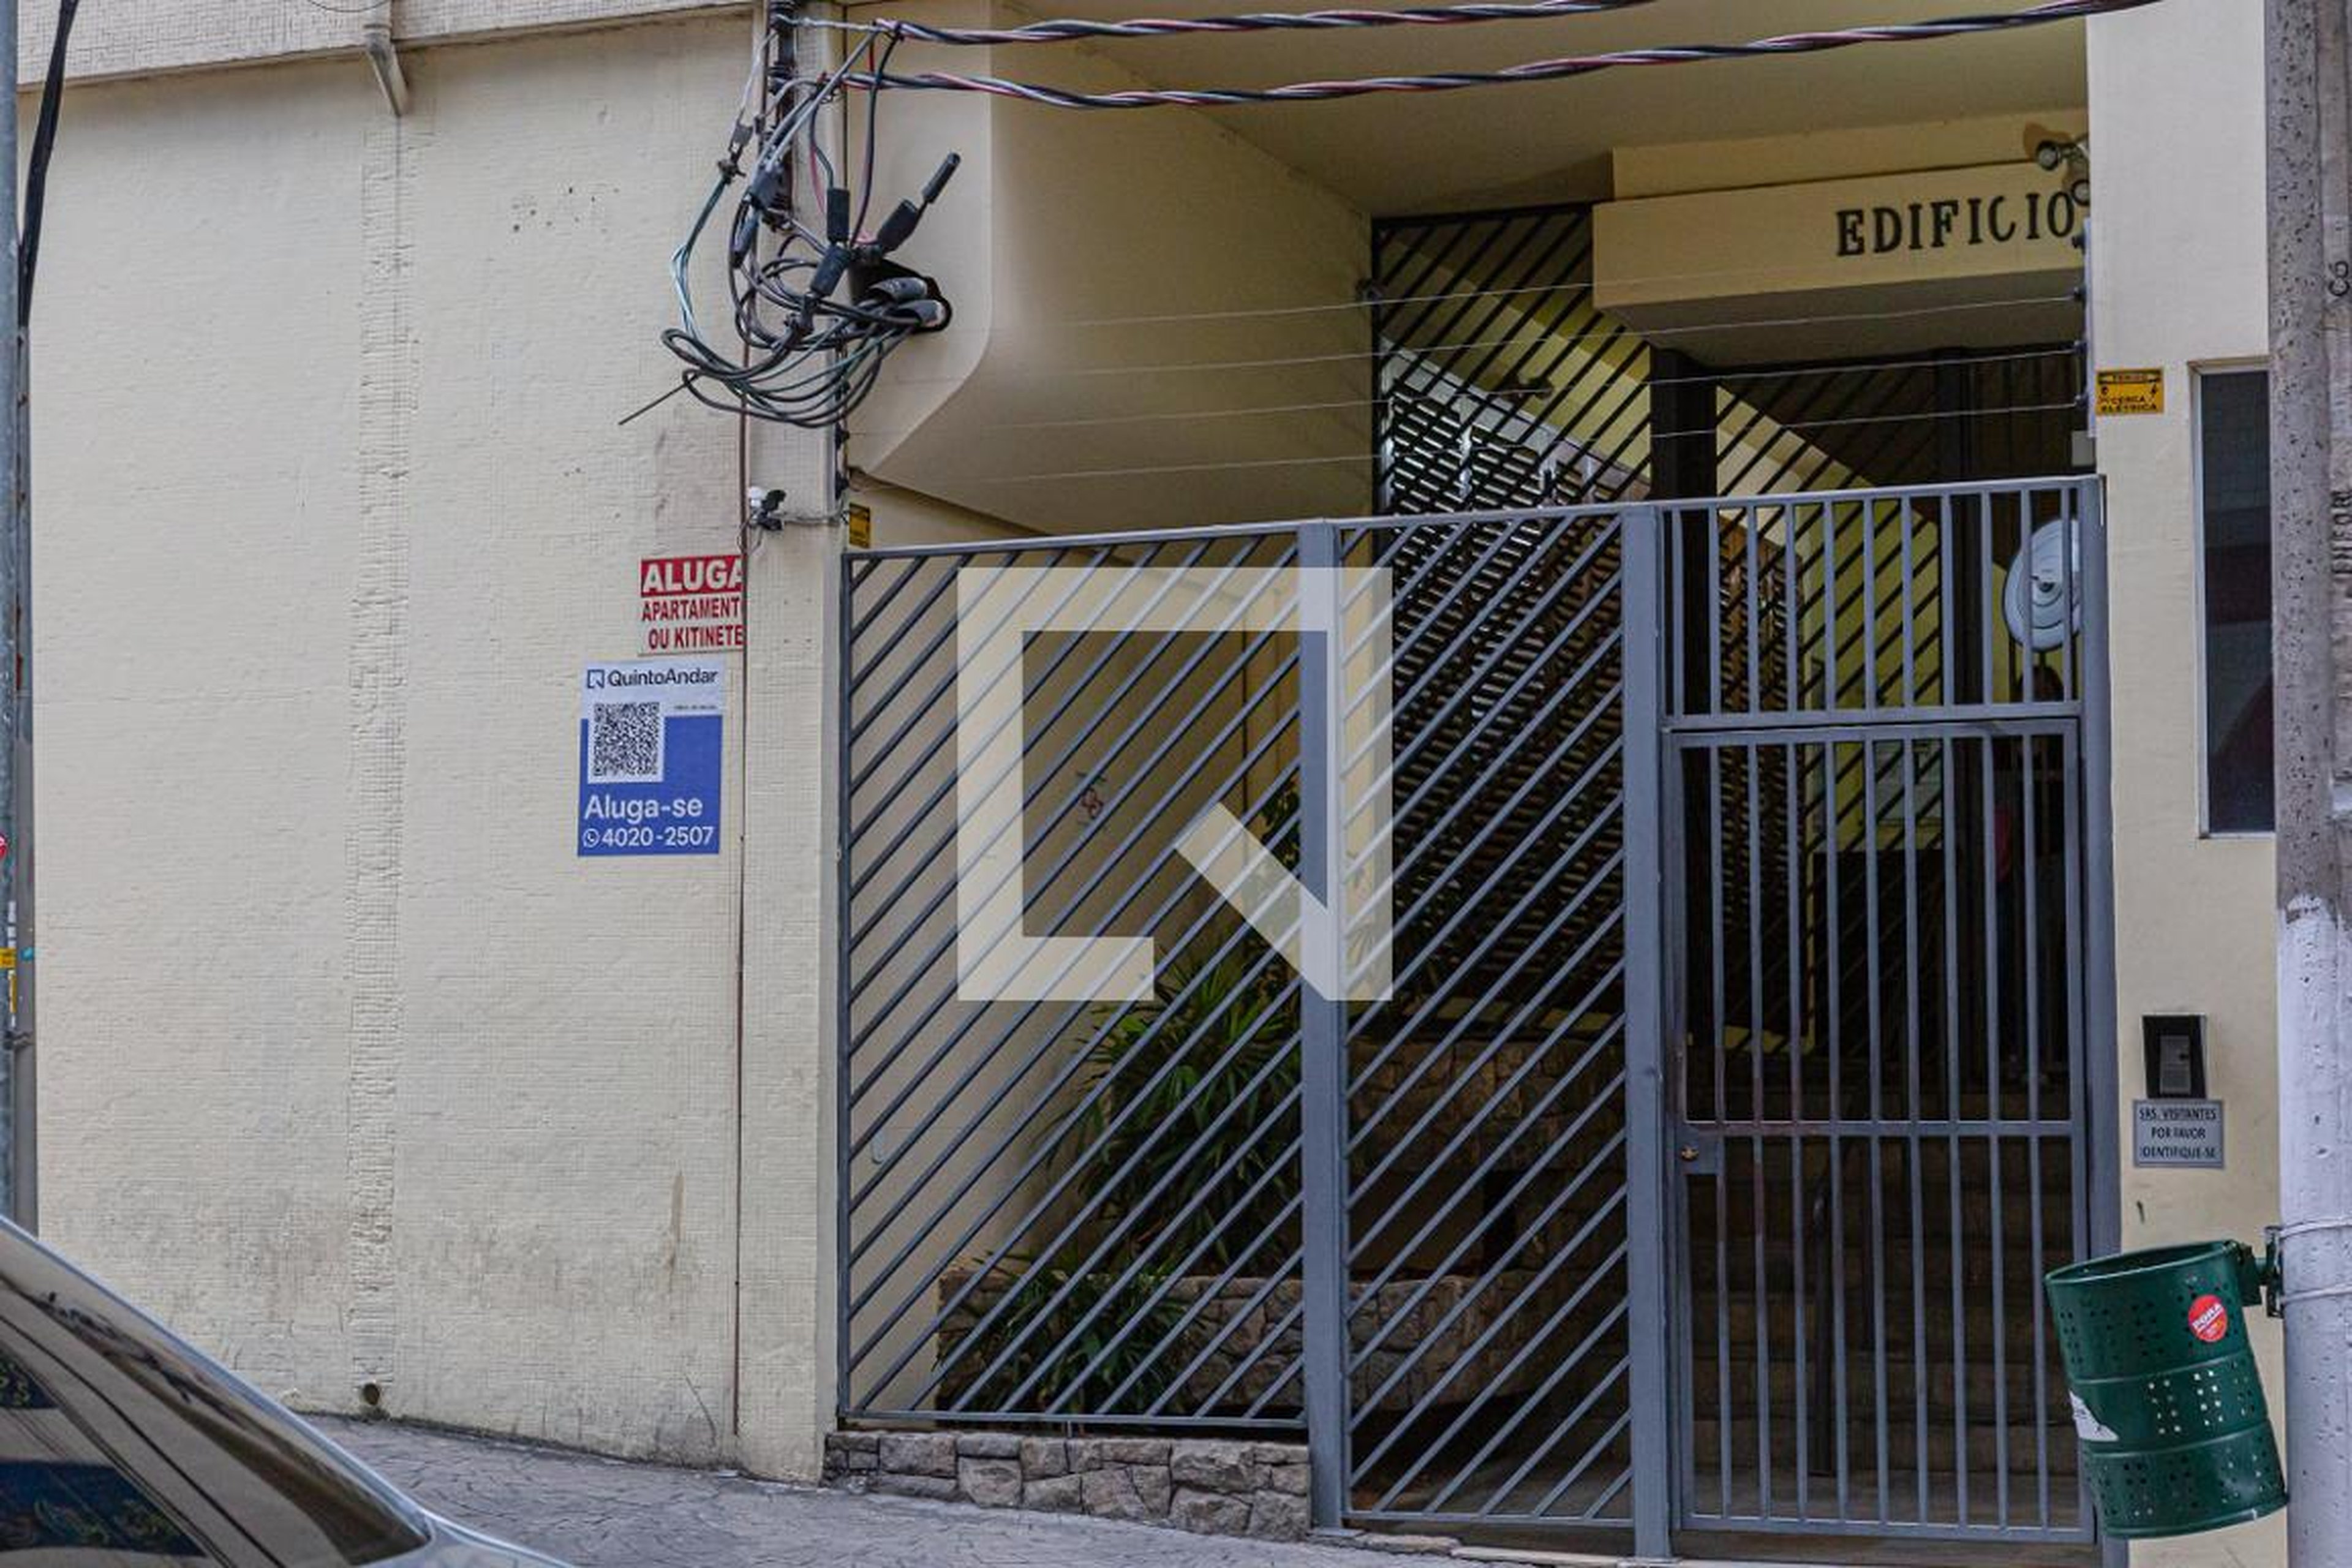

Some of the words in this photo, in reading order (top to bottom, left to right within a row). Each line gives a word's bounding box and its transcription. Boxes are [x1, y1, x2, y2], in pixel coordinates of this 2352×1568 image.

[1836, 191, 2074, 256] EDIFICIO
[643, 559, 742, 592] ALUGA
[649, 627, 669, 649] OU
[608, 668, 718, 687] QuintoAndar
[584, 794, 703, 824] Aluga-se
